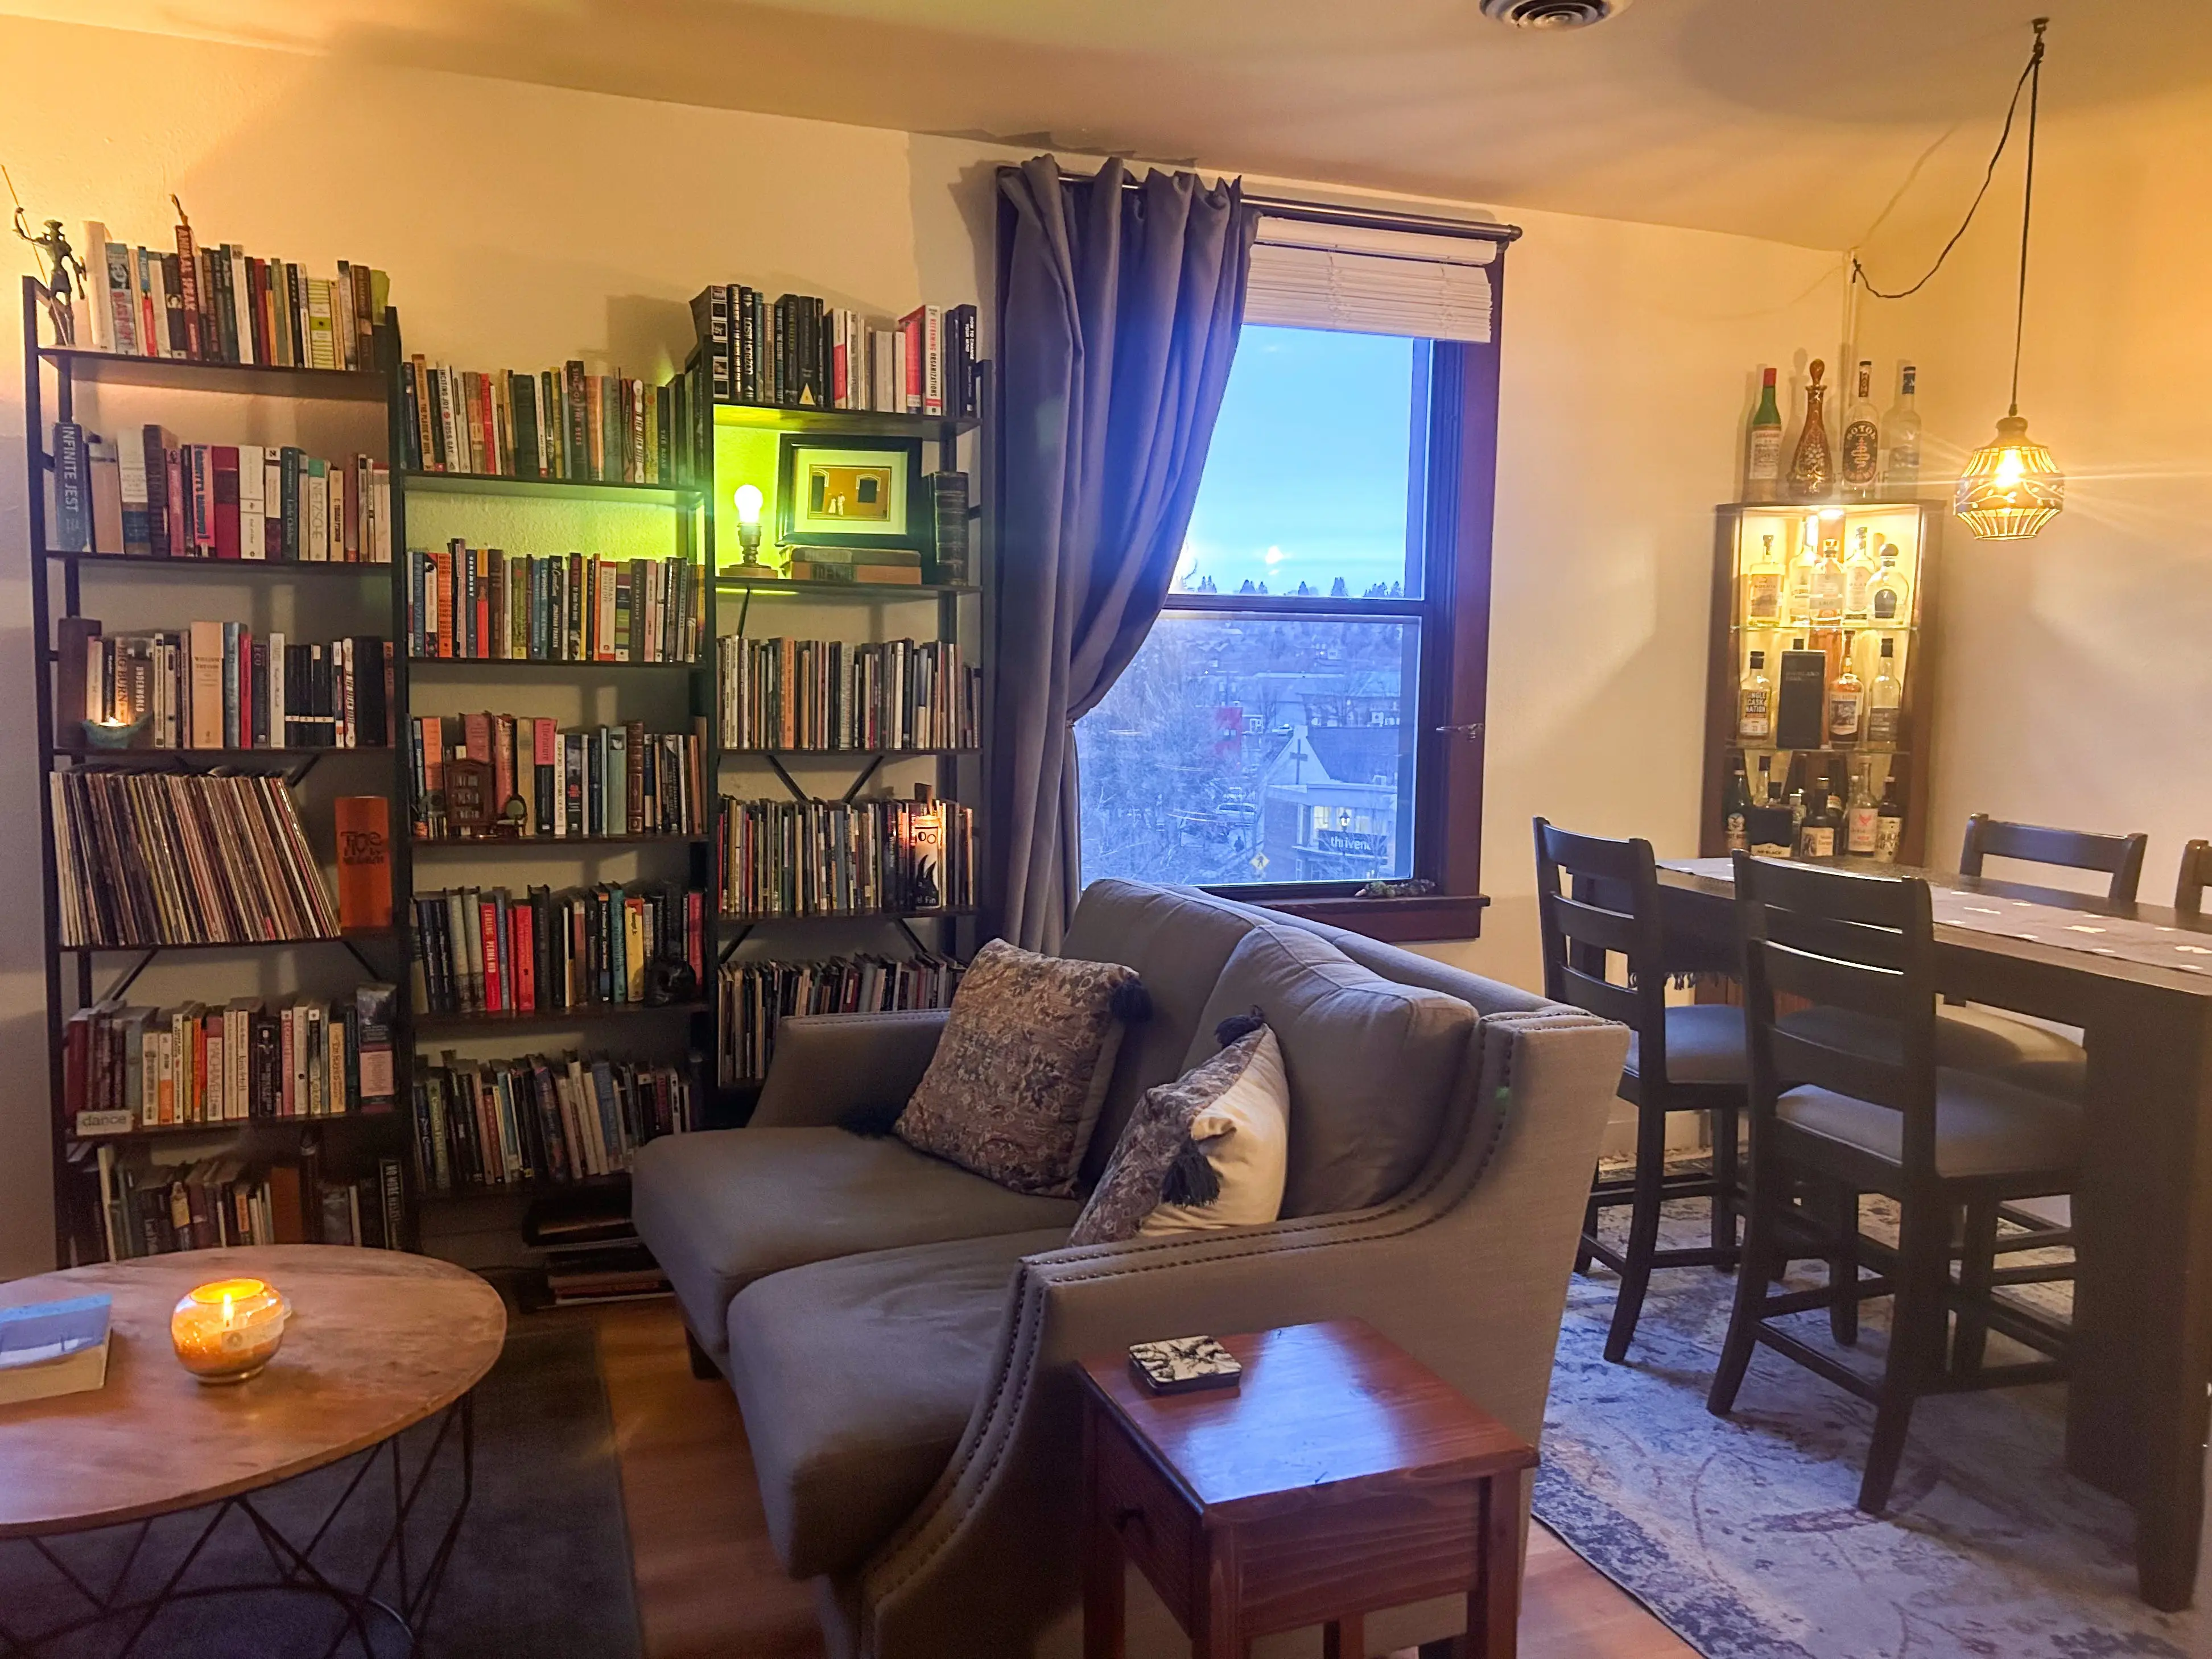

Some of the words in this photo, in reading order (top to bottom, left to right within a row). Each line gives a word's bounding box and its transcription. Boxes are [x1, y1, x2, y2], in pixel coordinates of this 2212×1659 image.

[178, 229, 192, 273] ANIMAL
[182, 278, 195, 311] SPEAK
[744, 317, 753, 339] LOST
[440, 369, 449, 397] INCITING
[1846, 424, 1876, 440] SOTOL
[63, 427, 77, 480] INFINITE
[446, 441, 455, 453] GAY
[65, 484, 79, 513] JEST
[311, 481, 324, 540] NIETZSCHE
[552, 569, 562, 597] Corrections
[117, 646, 127, 667] BIG
[117, 670, 129, 702] BURN
[135, 666, 145, 713] UNDERWORLD
[542, 723, 551, 761] Literature
[431, 1096, 443, 1132] Cascadia
[434, 1132, 443, 1151] Field
[385, 1165, 398, 1175] NO
[387, 1176, 400, 1196] MORE
